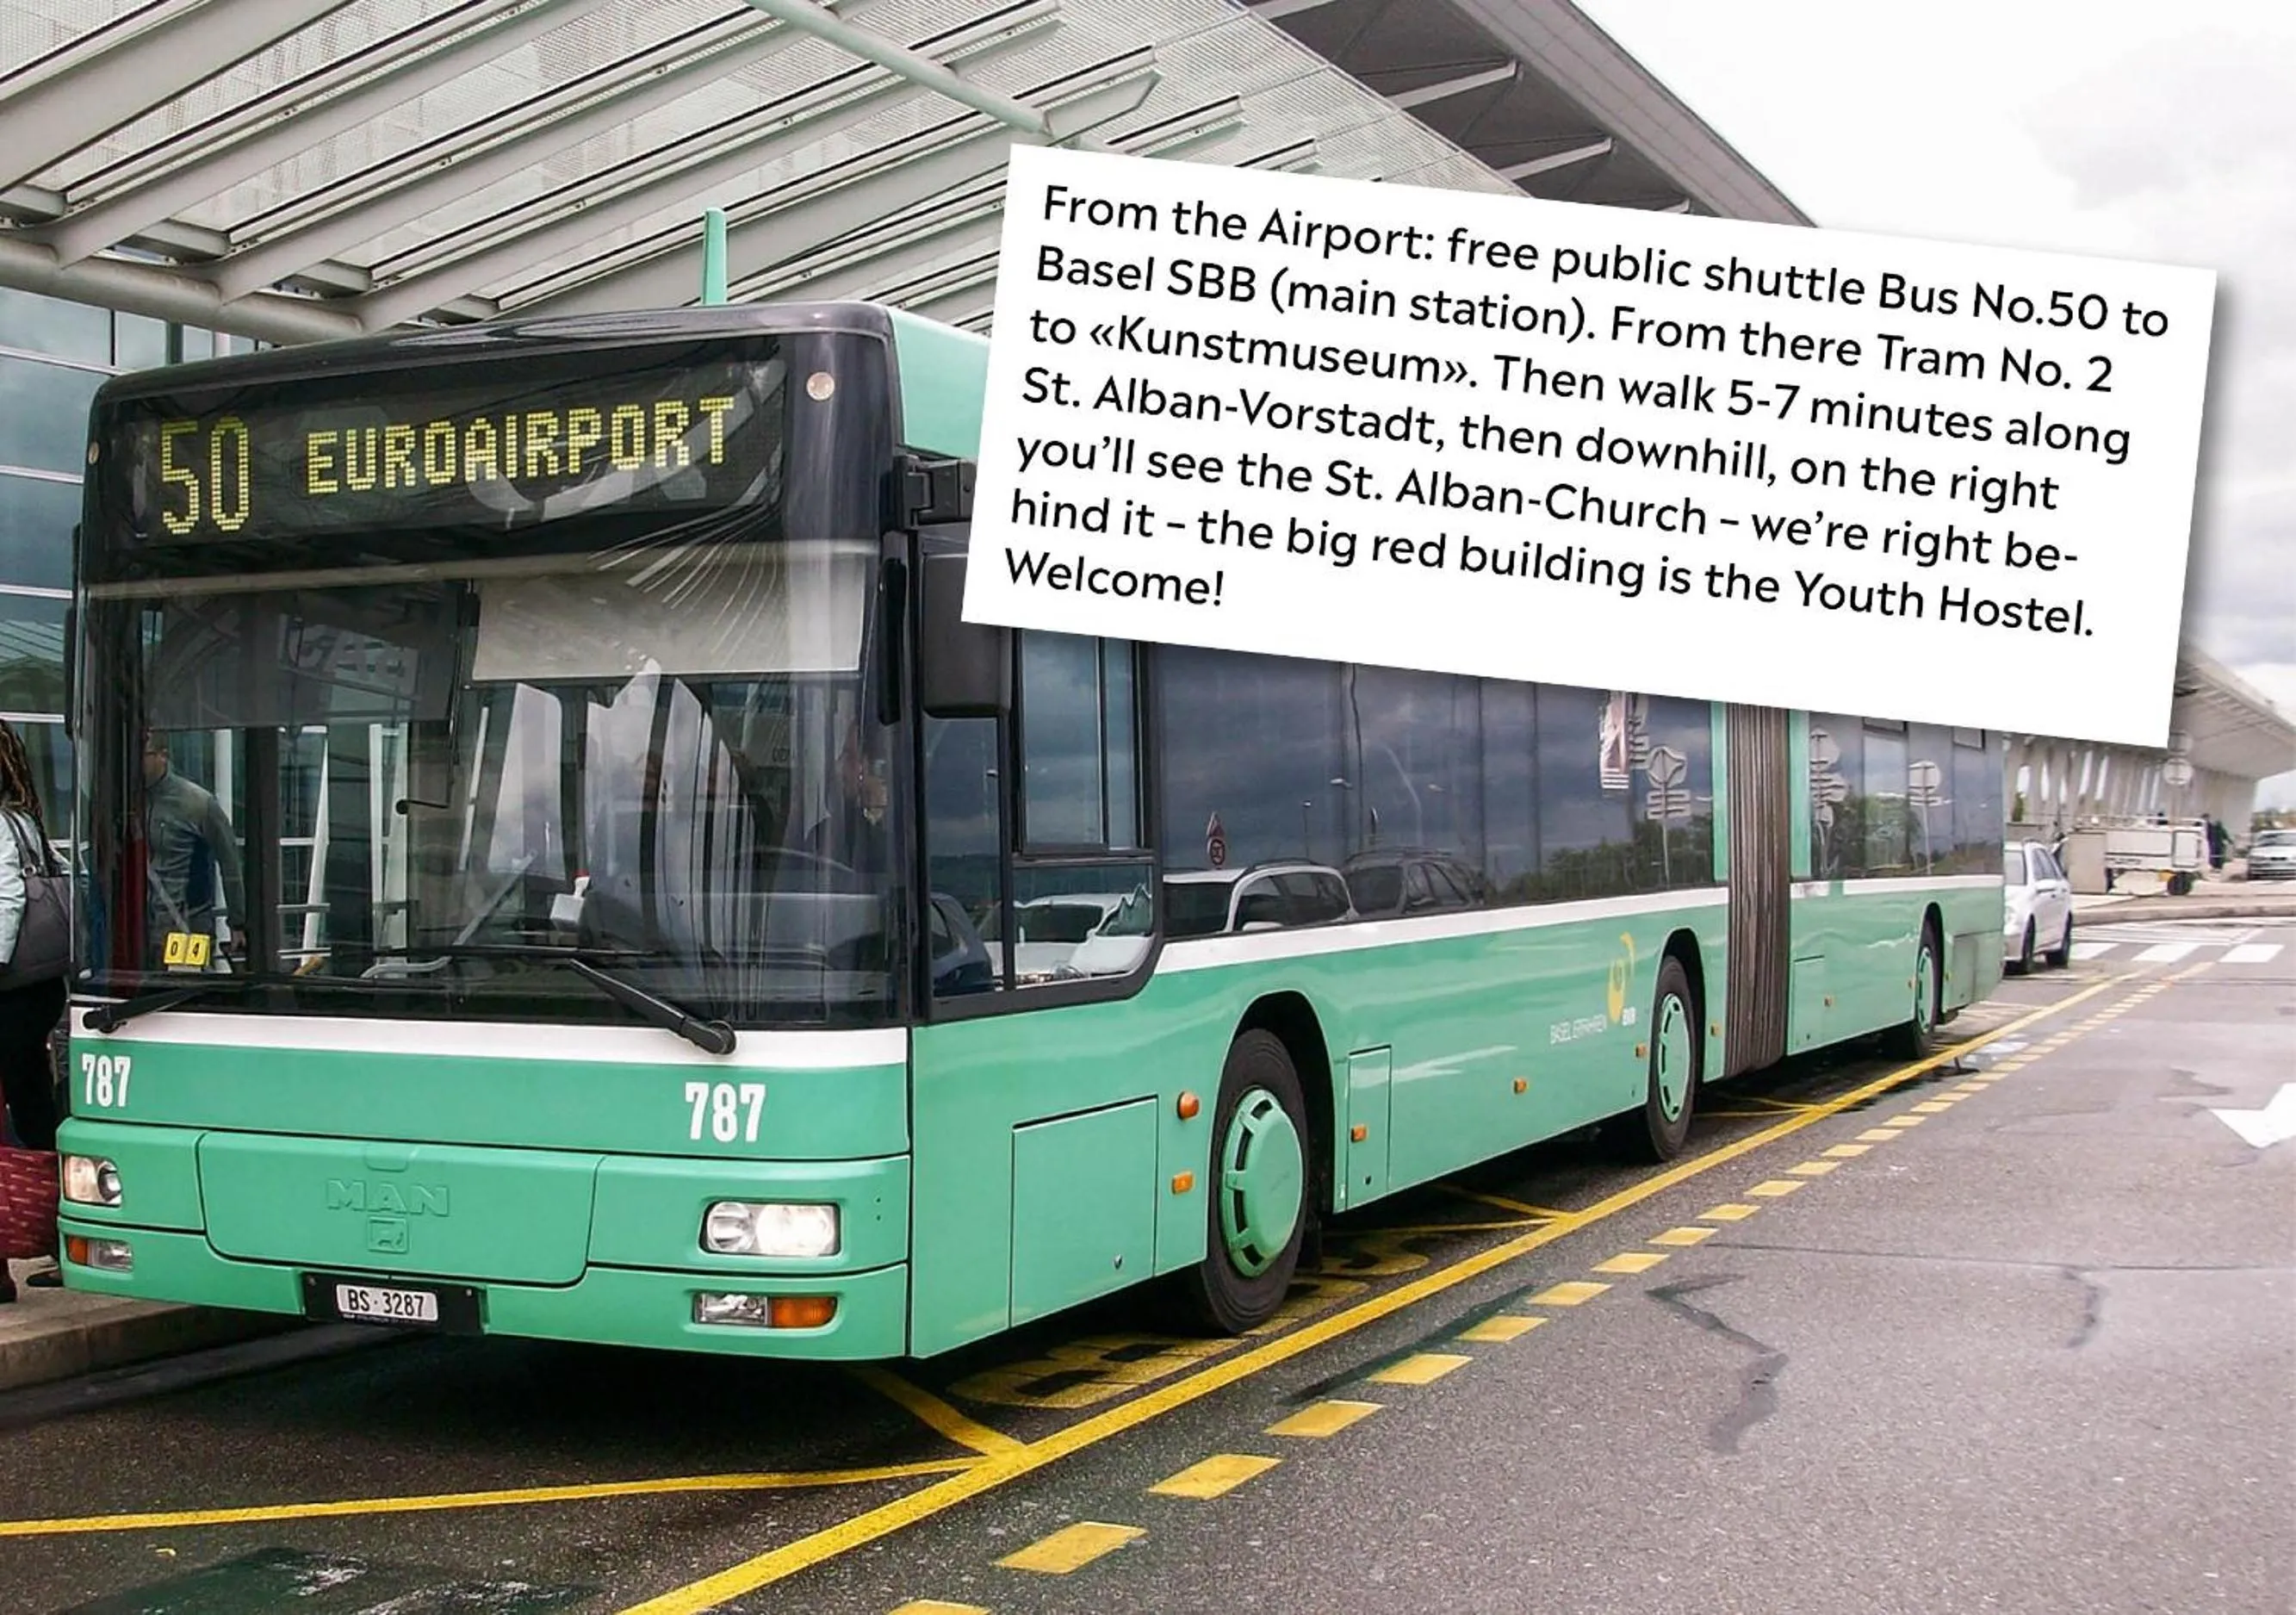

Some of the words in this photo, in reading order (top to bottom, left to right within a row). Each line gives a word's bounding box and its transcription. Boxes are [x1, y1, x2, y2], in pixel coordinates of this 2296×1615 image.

[160, 416, 251, 534] 50
[307, 395, 735, 494] EUROAIRPORT
[82, 1053, 131, 1108] 787
[685, 1082, 766, 1142] 787
[327, 1178, 450, 1218] MAN
